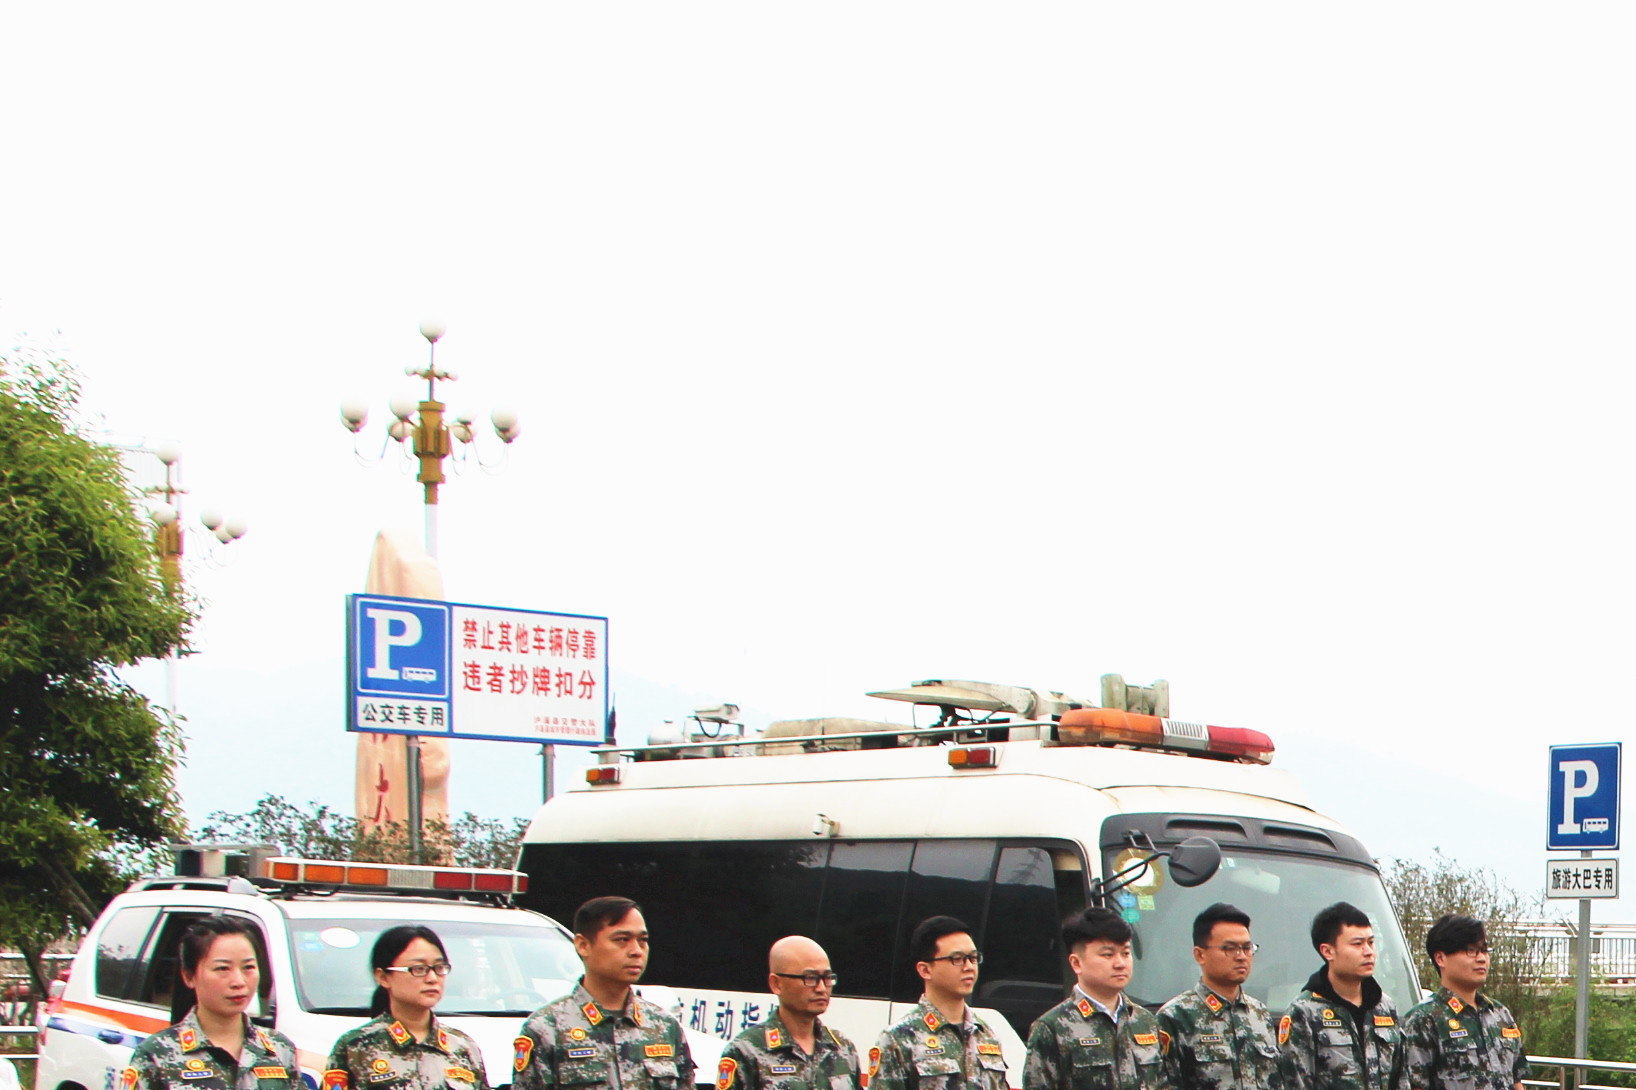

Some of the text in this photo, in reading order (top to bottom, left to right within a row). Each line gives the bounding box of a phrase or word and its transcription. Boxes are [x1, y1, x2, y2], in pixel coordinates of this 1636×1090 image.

[366, 608, 422, 680] P
[463, 617, 597, 660] 禁止其他车辆停靠
[463, 660, 597, 700] 违者抄牌扣分
[363, 703, 444, 726] 公交车专用
[1558, 760, 1599, 834] P
[1551, 867, 1613, 890] 旅游大巴专用
